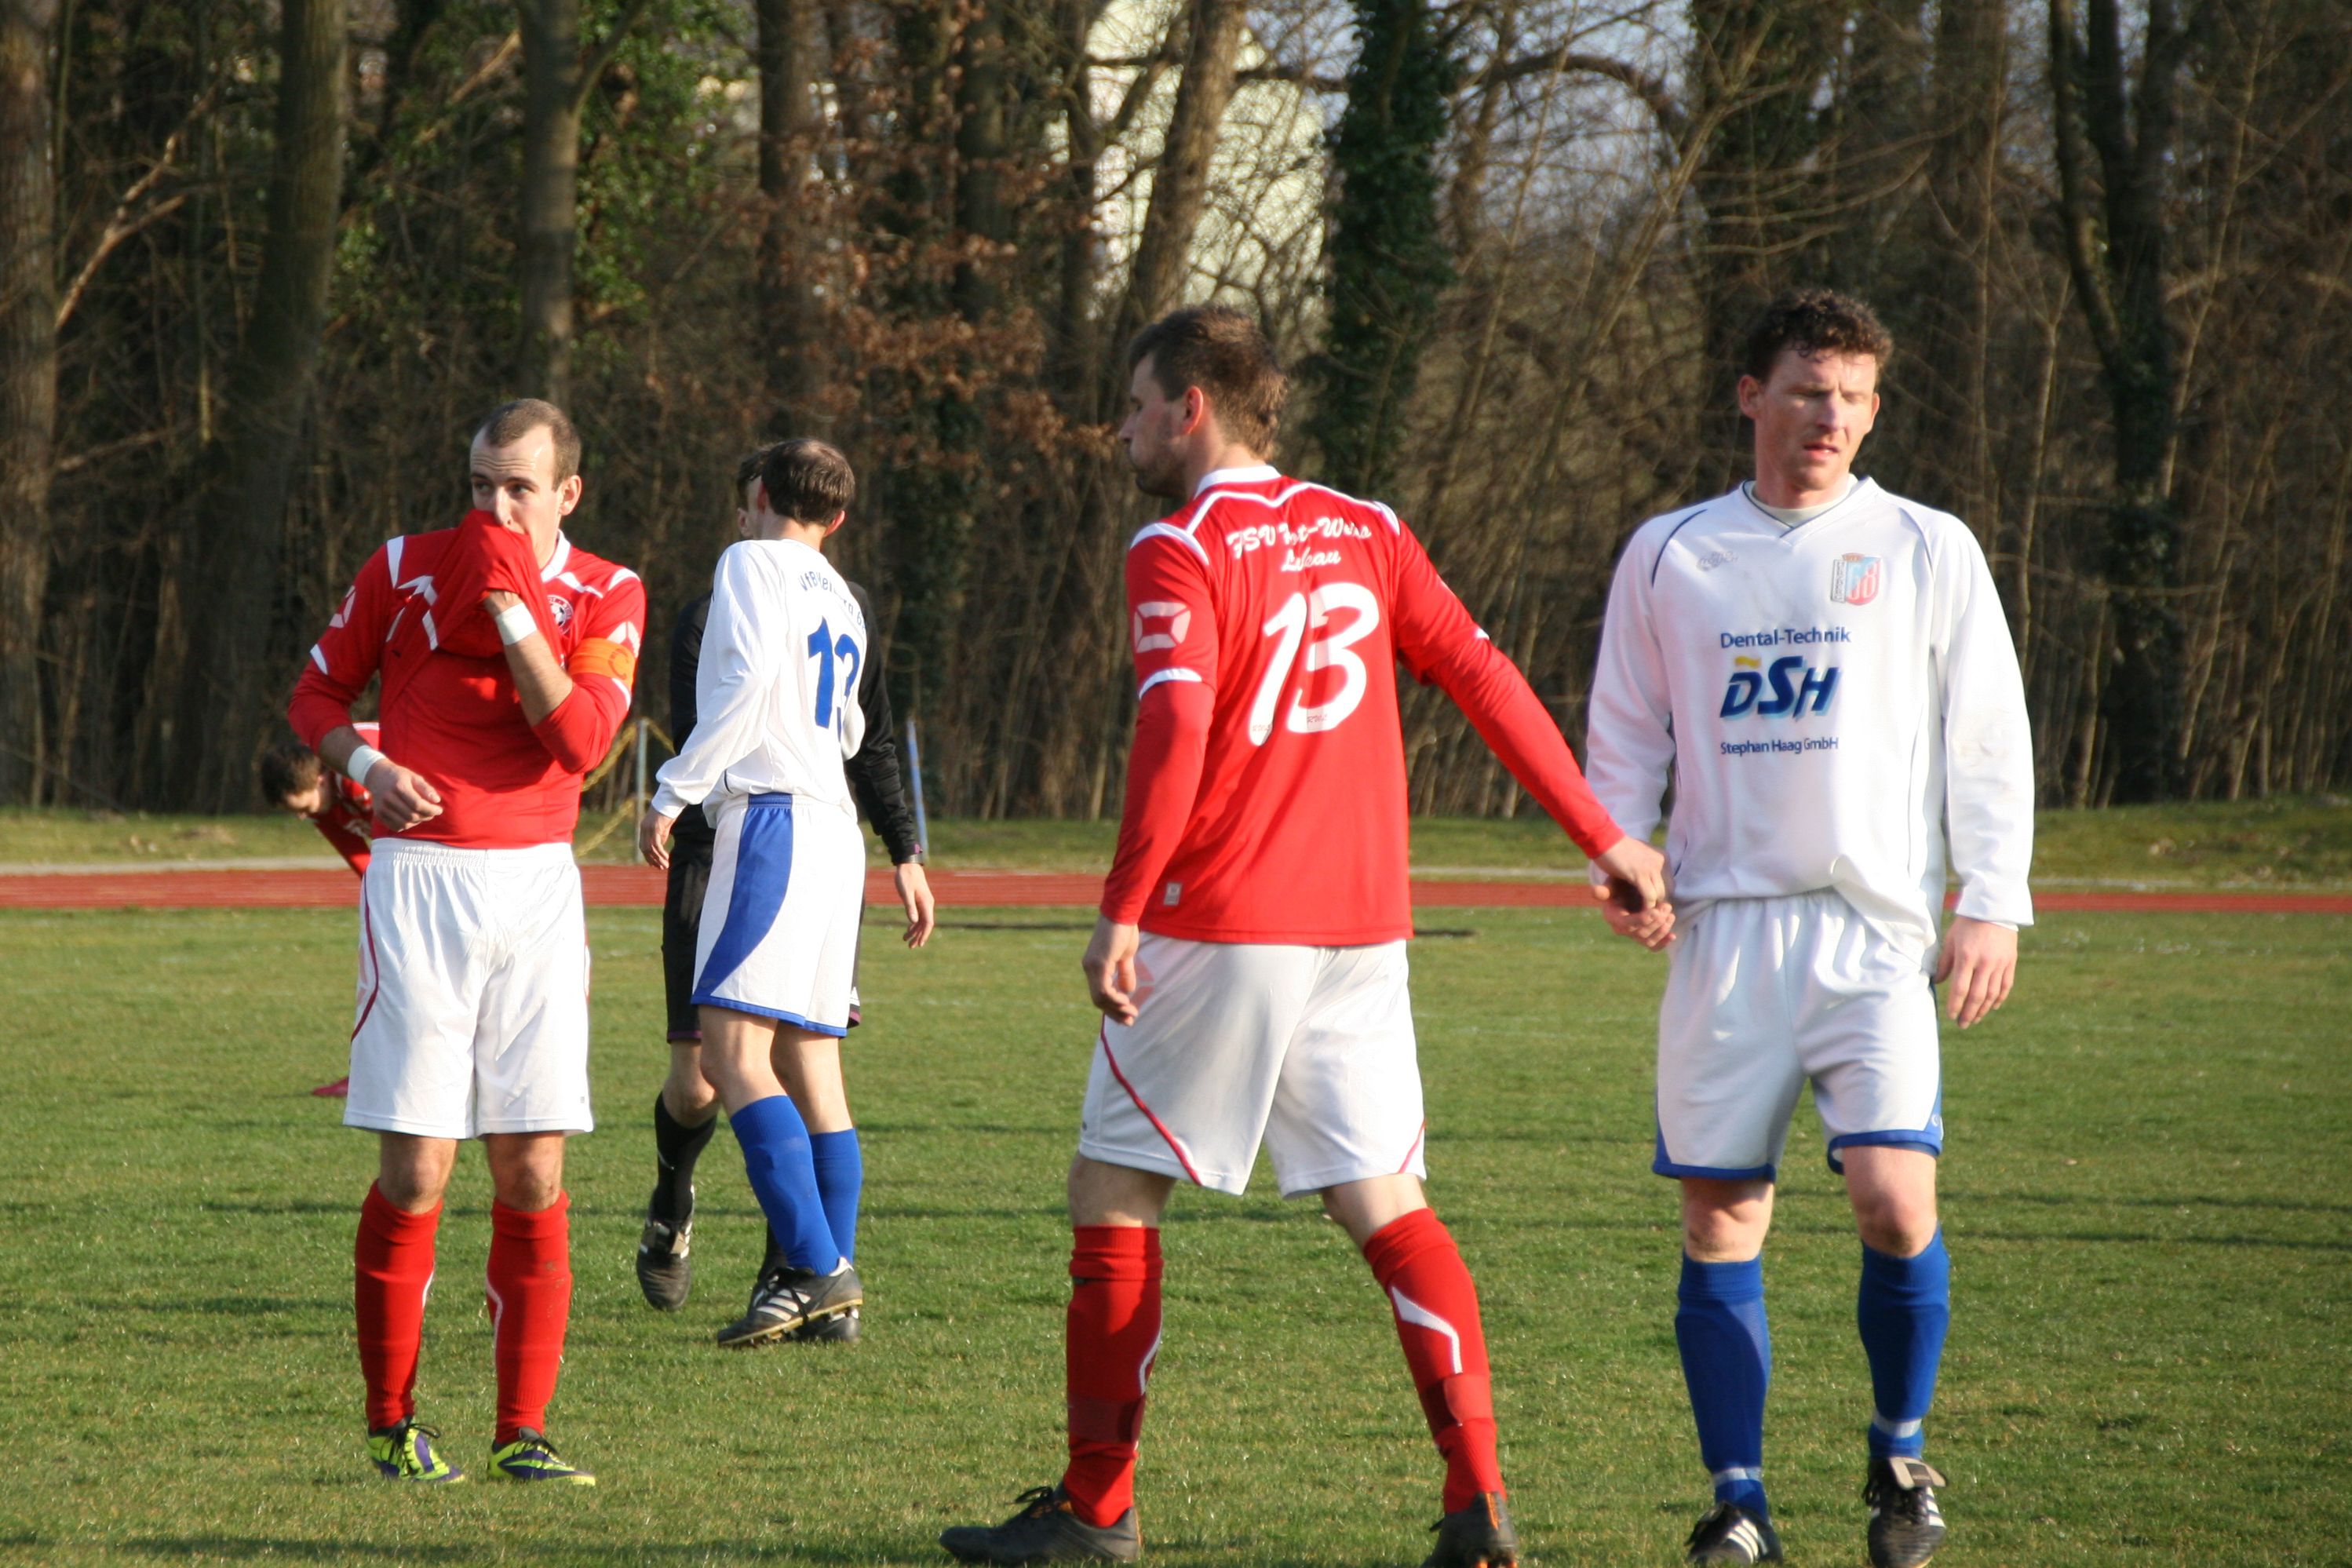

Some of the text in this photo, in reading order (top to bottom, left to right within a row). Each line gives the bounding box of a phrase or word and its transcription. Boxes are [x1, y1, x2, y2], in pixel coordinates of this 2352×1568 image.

[1224, 524, 1277, 560] FSV
[1719, 626, 1851, 649] Dental-Technik
[607, 647, 629, 680] C
[1249, 582, 1380, 747] 13
[1719, 655, 1843, 720] DSH
[1720, 737, 1840, 757] Stephan Haag GmbH
